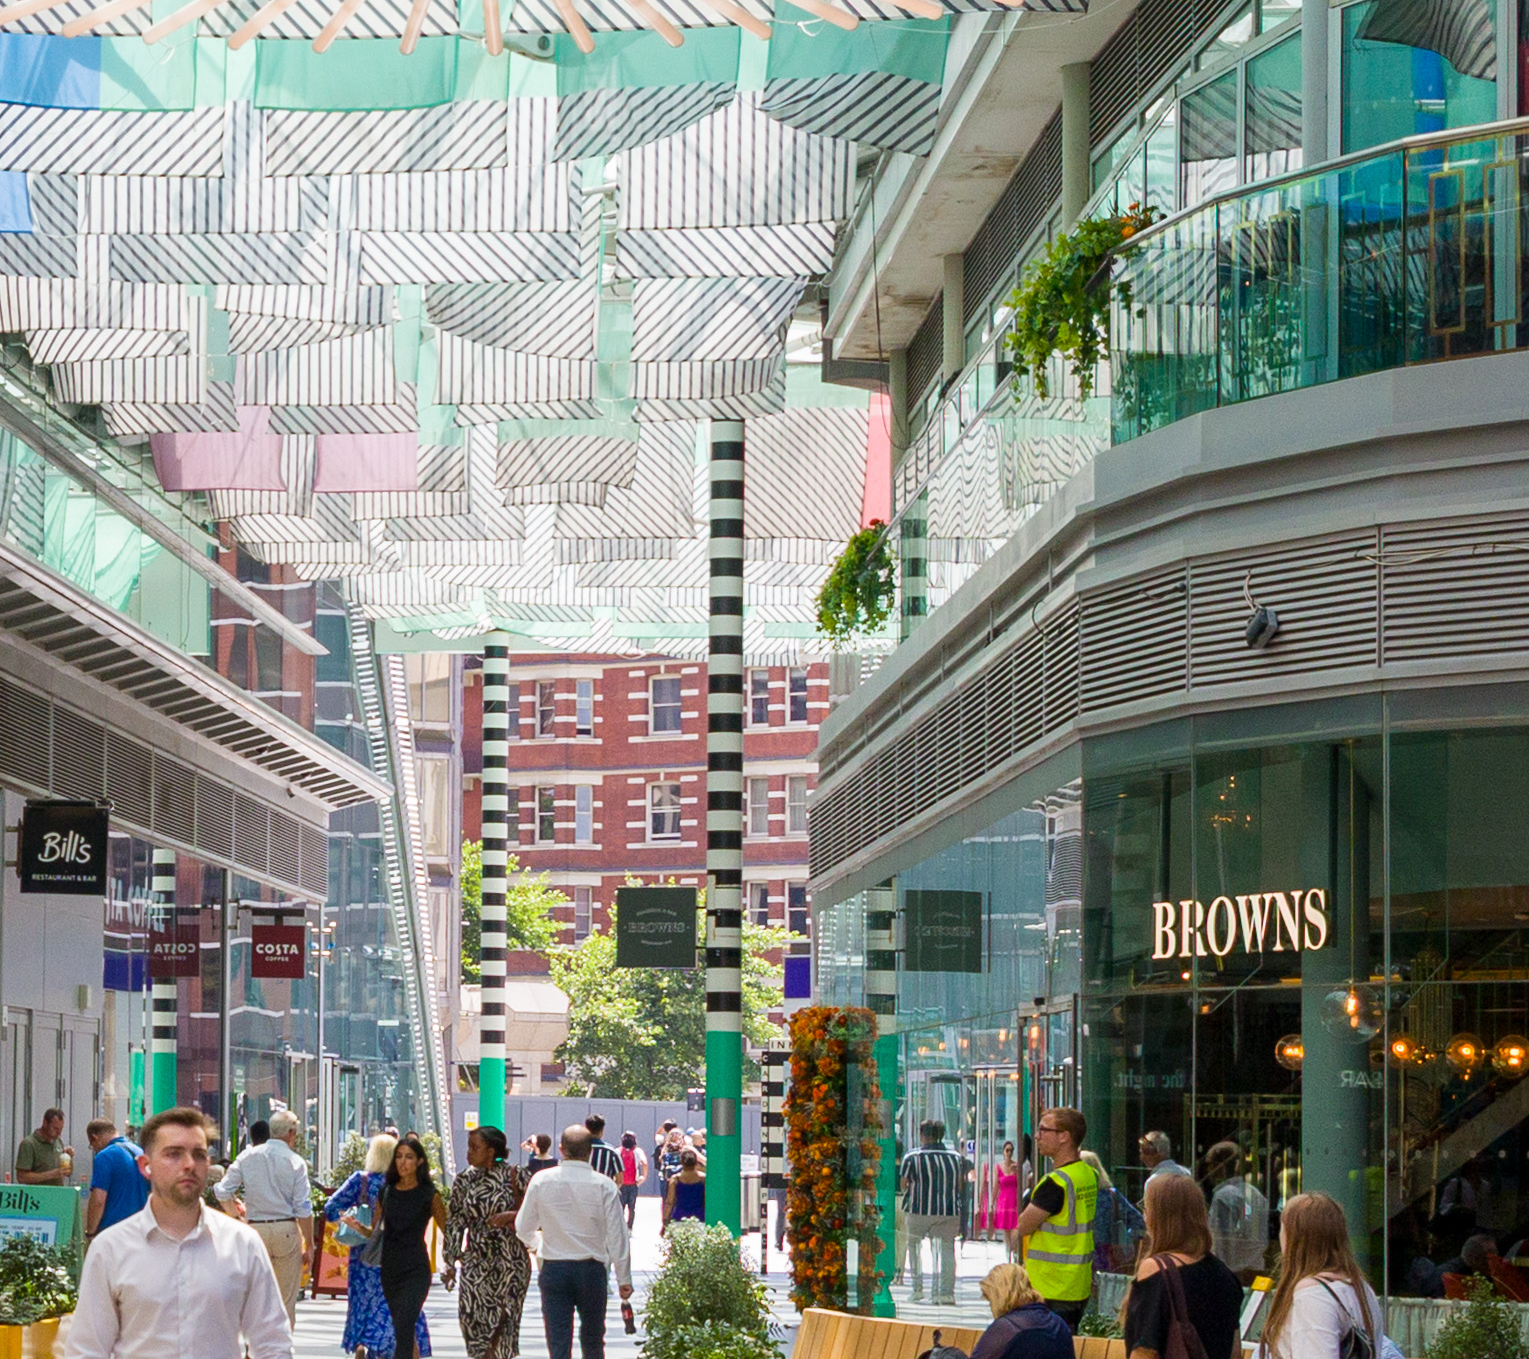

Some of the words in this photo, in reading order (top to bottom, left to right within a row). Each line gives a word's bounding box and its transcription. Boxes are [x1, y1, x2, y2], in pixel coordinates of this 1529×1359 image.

[38, 830, 92, 864] Bill's
[32, 873, 73, 882] RESTAURANT
[84, 874, 97, 882] BAR
[627, 922, 686, 933] BROWNS
[1151, 889, 1328, 960] BROWNS
[255, 943, 300, 955] COSTA
